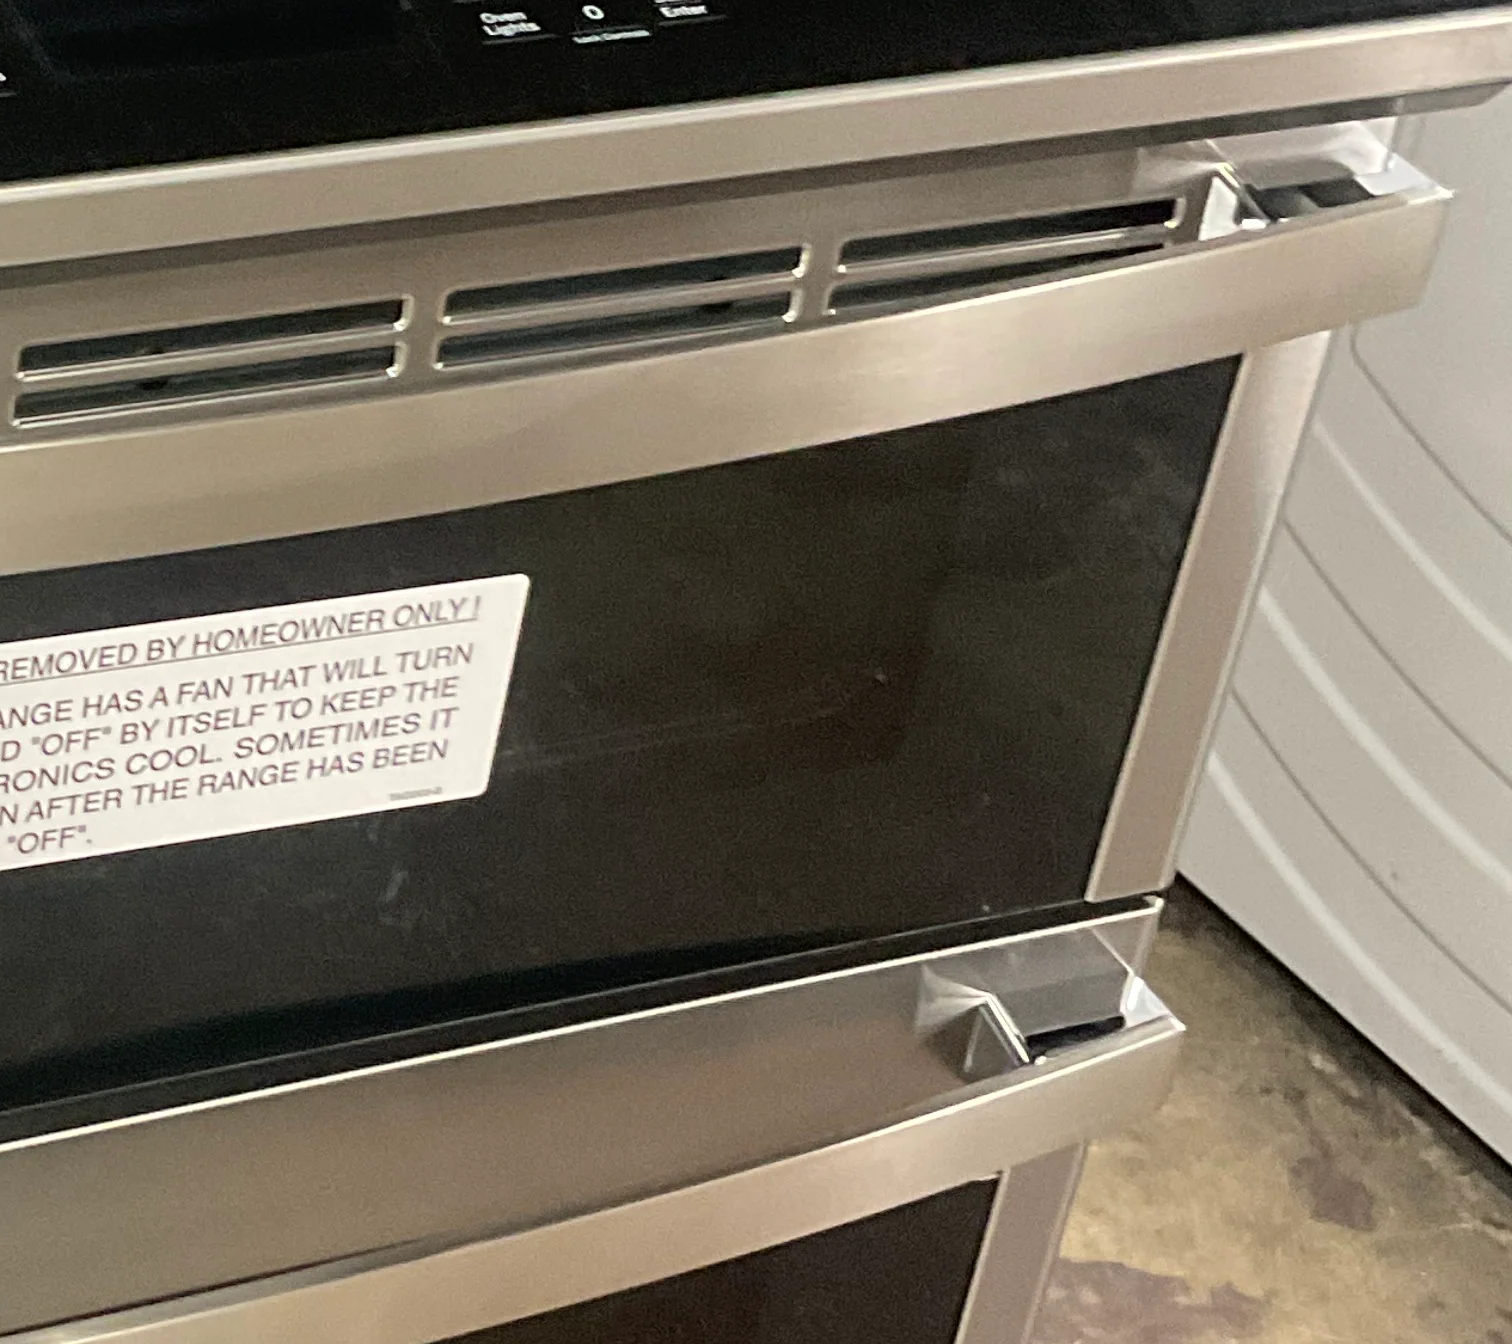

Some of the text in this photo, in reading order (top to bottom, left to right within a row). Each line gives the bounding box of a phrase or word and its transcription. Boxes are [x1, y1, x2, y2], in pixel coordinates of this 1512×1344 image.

[581, 4, 606, 20] 0
[146, 635, 187, 662] BY
[192, 609, 386, 656] HOMEOWNER
[31, 726, 112, 757] "OFF"
[120, 718, 160, 745] BY
[167, 703, 268, 739] ITSELF
[274, 697, 313, 722] TO
[319, 685, 398, 716] KEEP
[402, 676, 460, 704] THE
[82, 689, 145, 718] HAS
[149, 686, 169, 709] A
[177, 676, 234, 705] FAN
[241, 665, 317, 695] THAT
[323, 656, 389, 684] WILL
[395, 643, 475, 674] TURN
[124, 743, 223, 776] COOL.
[234, 712, 422, 759] SOMETIMES
[429, 706, 460, 732] IT
[24, 788, 124, 824] AFTER
[130, 777, 191, 806] THE
[196, 761, 300, 796] RANGE
[306, 751, 365, 781] HAS
[370, 738, 450, 770] BEEN
